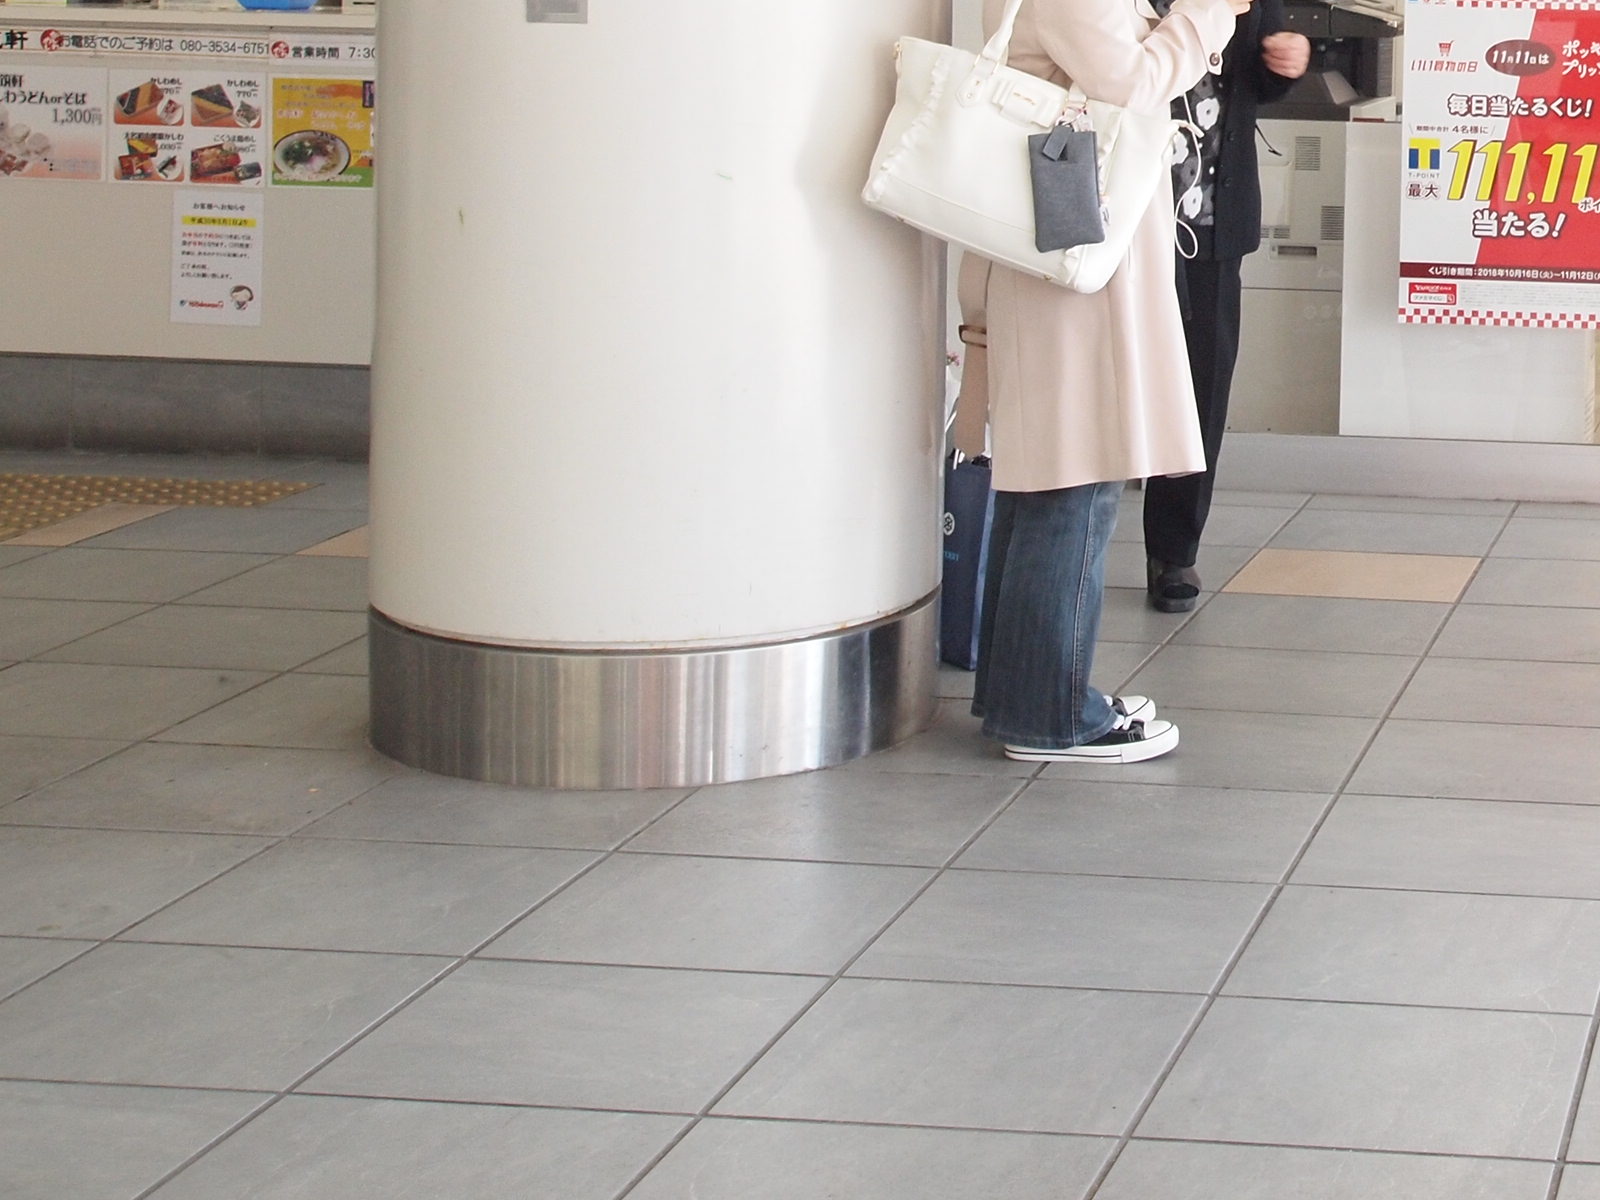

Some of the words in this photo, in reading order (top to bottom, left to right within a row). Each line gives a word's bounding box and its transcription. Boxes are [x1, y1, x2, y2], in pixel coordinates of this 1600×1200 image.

[60, 35, 173, 50] お電話でのご予約は
[180, 39, 269, 54] 080-3534-6751
[292, 47, 339, 59] 営業時間
[1492, 50, 1550, 65] 11月11日は
[1411, 60, 1479, 73] いい買物の日
[0, 90, 86, 105] わうどんorそば
[1447, 94, 1593, 119] 毎日当たるくじ!
[1452, 125, 1489, 134] 4名様に
[1407, 184, 1438, 198] 最大
[1473, 209, 1567, 238] 当たる!
